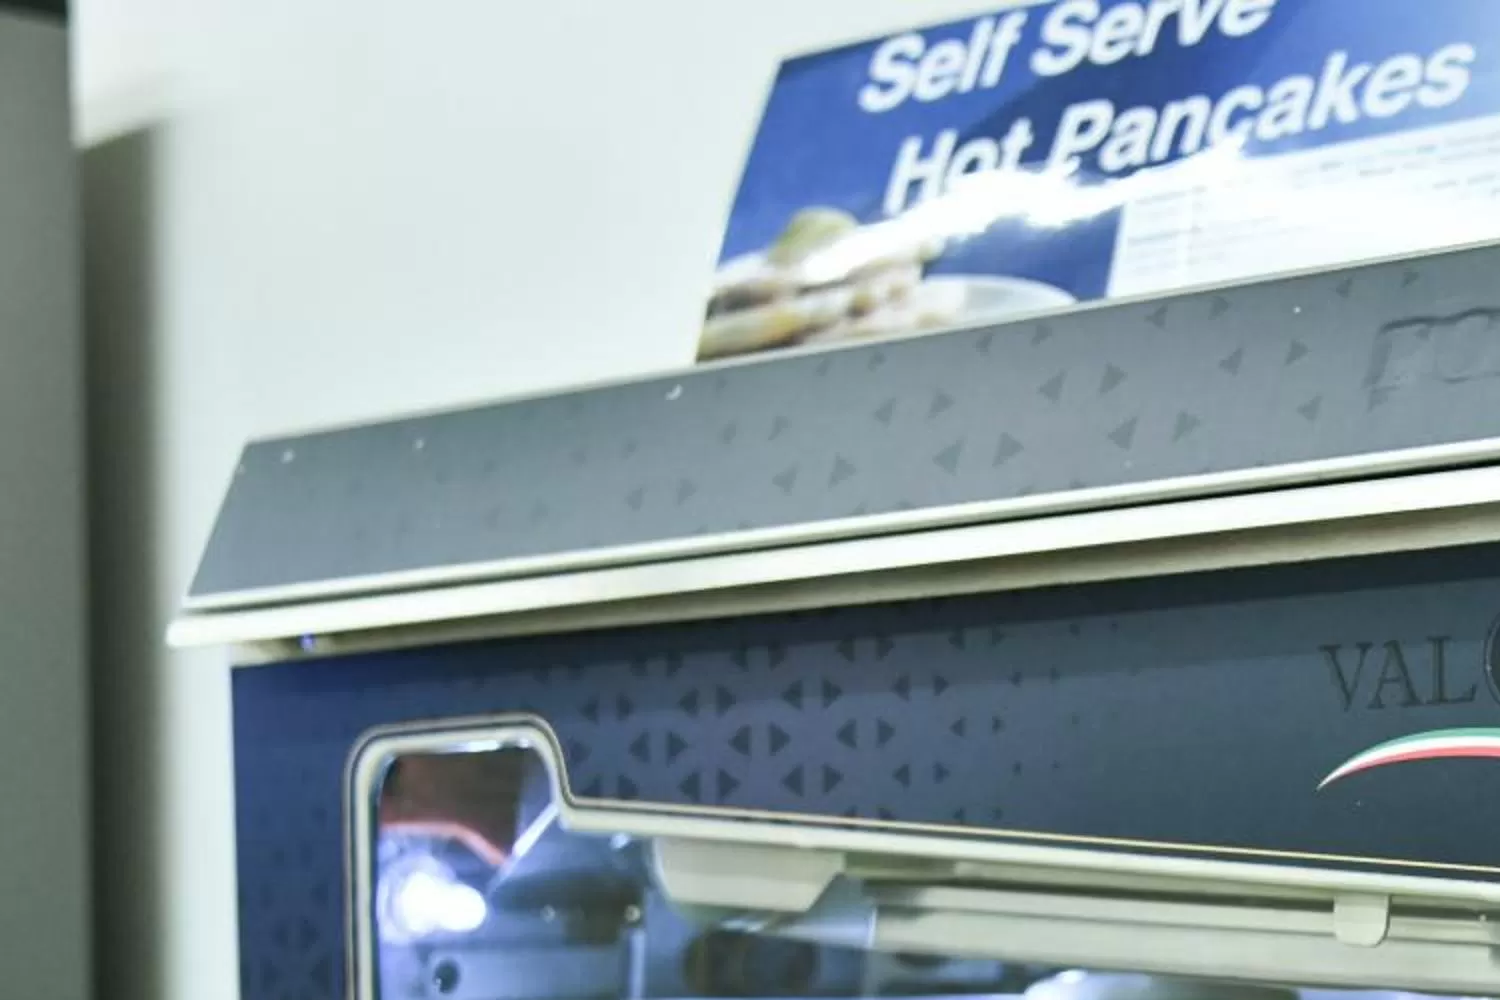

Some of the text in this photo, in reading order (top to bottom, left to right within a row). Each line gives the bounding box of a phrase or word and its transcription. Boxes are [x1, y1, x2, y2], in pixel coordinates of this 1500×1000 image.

[858, 0, 1276, 113] Self Serve
[1047, 42, 1476, 176] Pancakes
